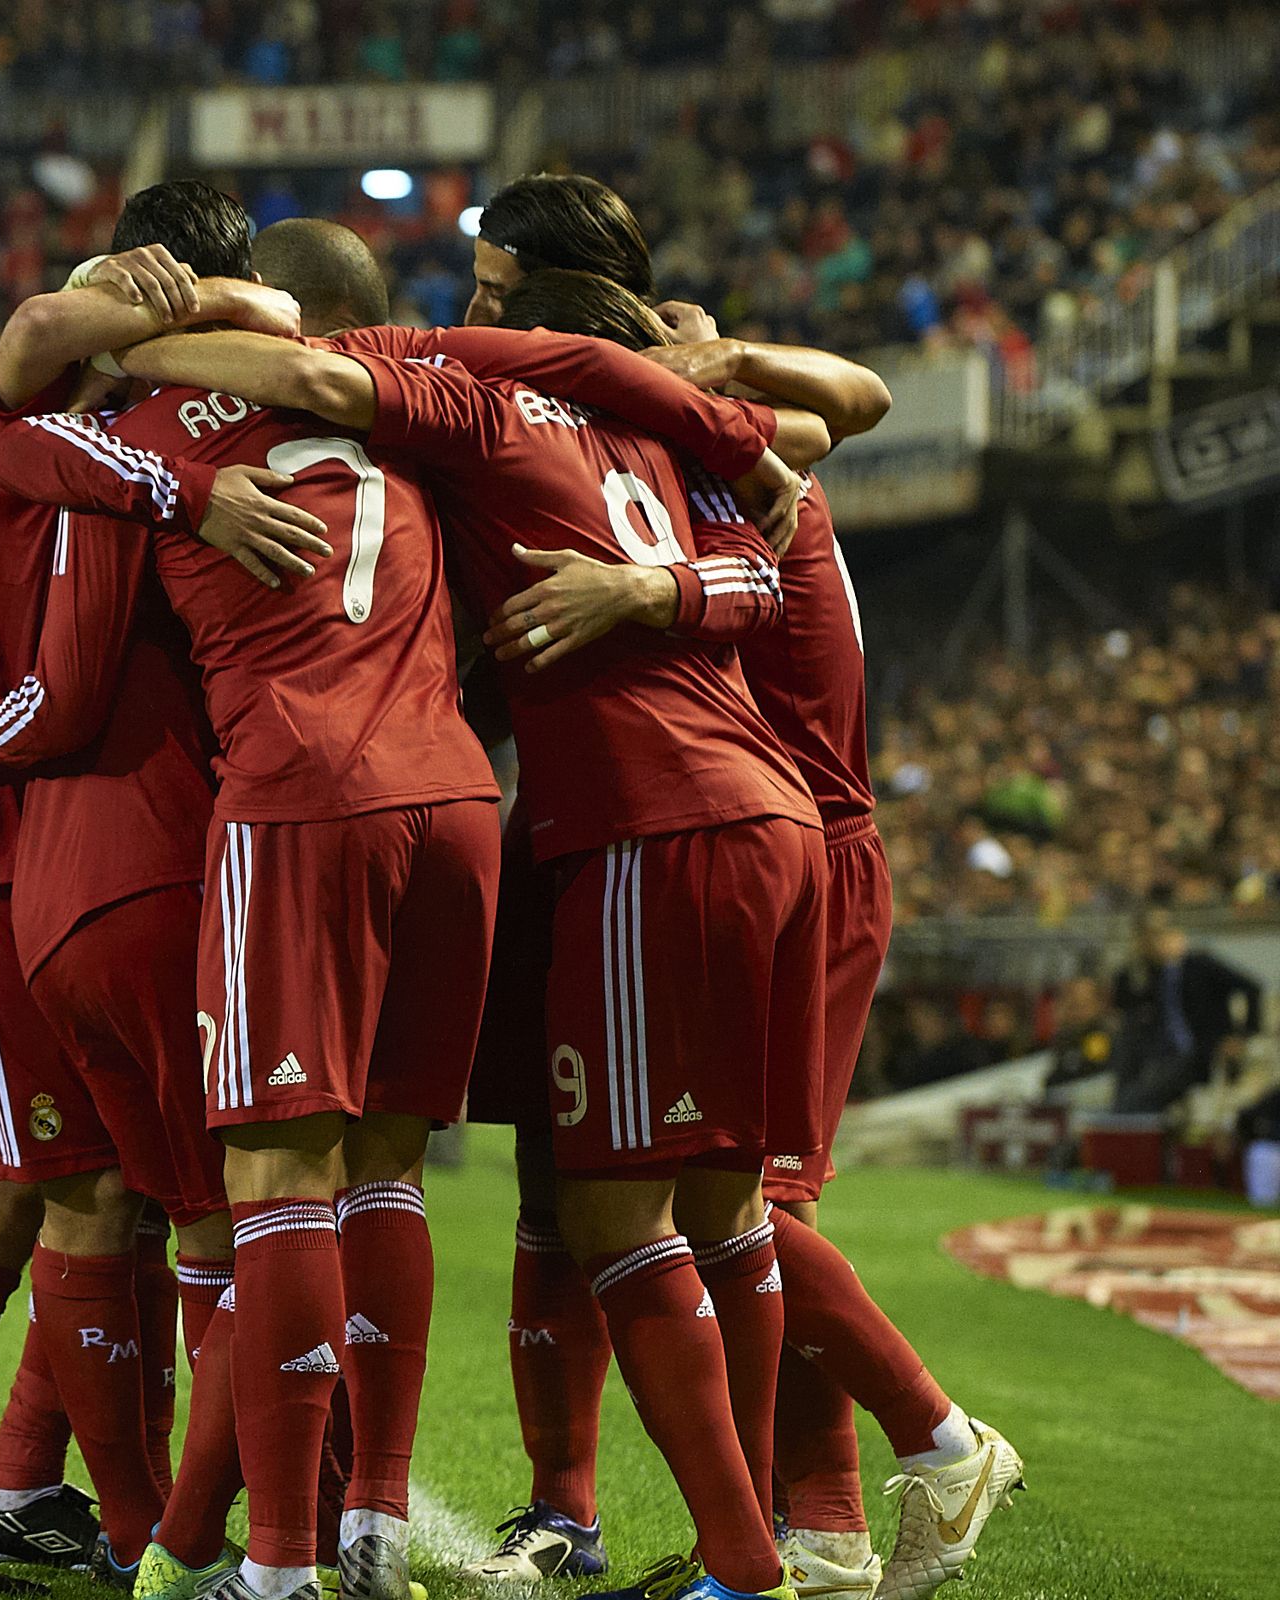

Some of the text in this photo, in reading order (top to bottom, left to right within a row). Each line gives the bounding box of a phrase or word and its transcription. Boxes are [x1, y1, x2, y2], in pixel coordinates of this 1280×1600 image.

[178, 391, 261, 438] RO
[267, 436, 386, 623] 7
[268, 1072, 307, 1086] adidas
[552, 1044, 587, 1126] 9
[663, 1110, 703, 1124] adidas
[773, 1156, 803, 1171] adidas
[280, 1361, 340, 1374] adidas
